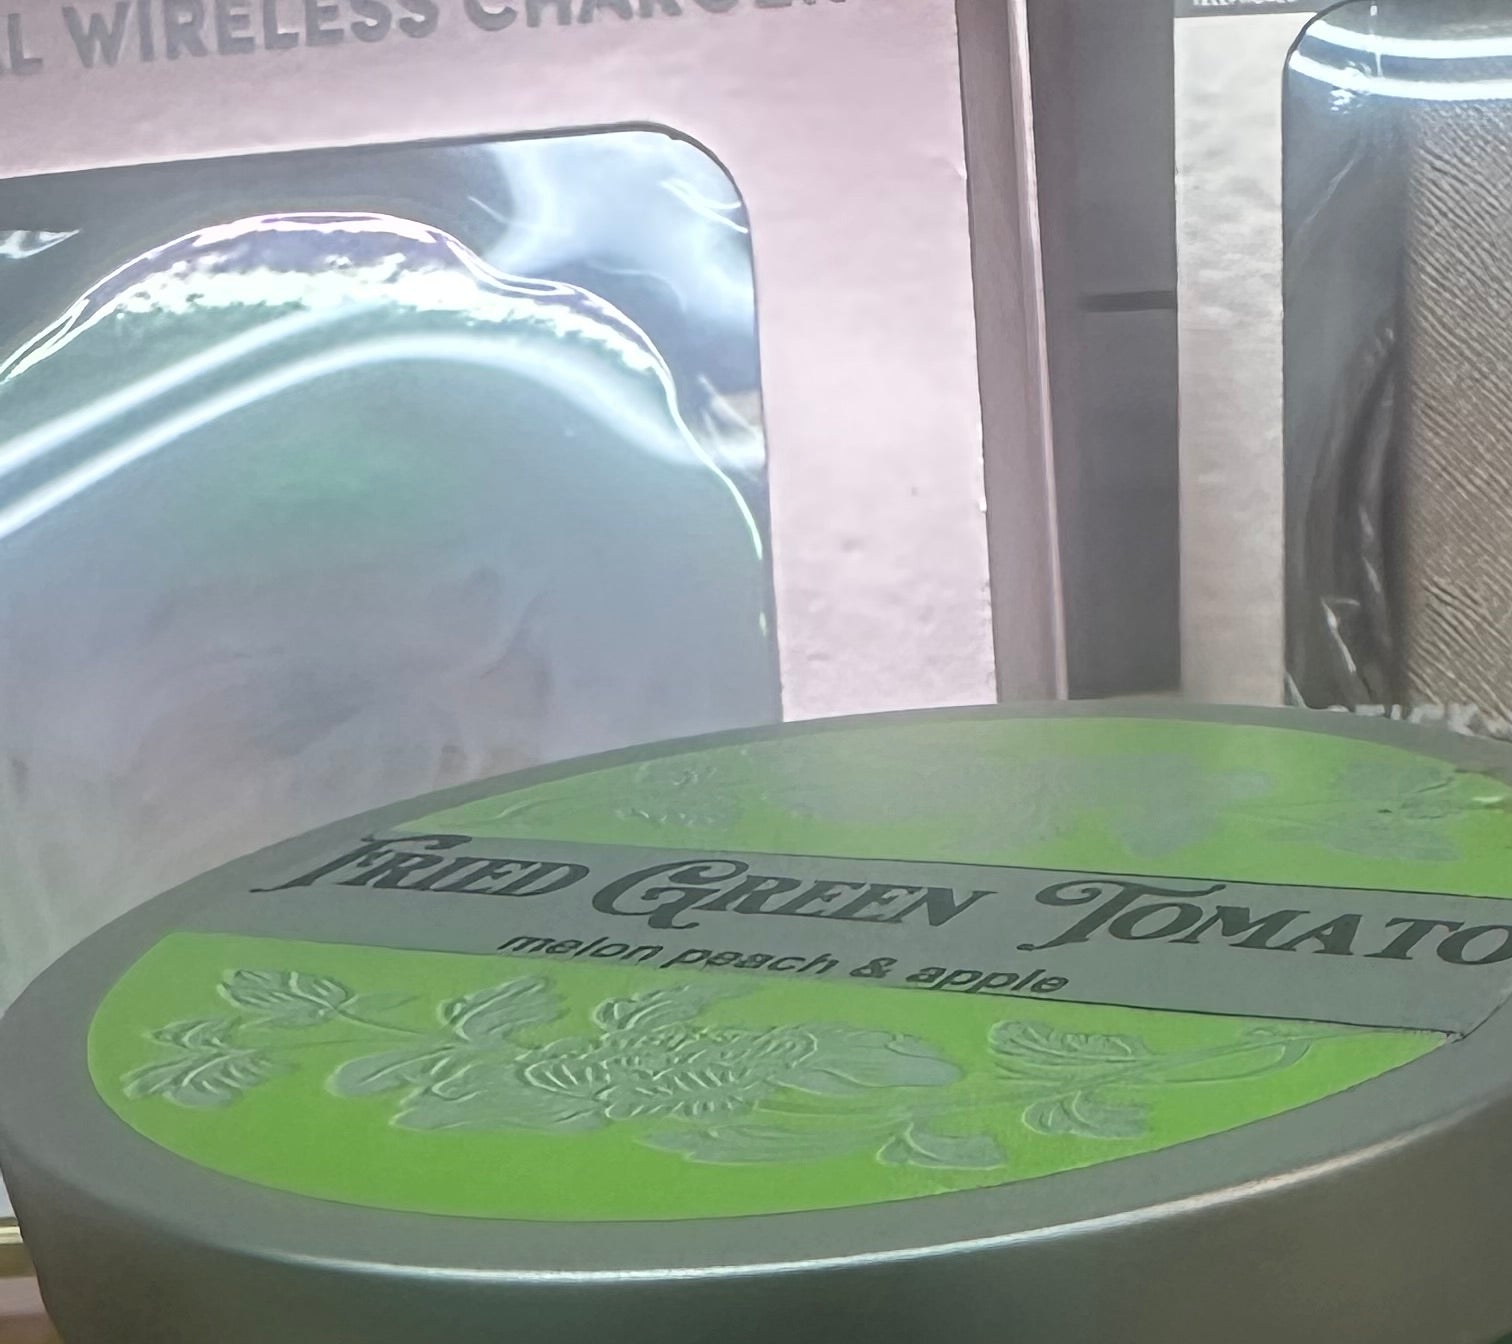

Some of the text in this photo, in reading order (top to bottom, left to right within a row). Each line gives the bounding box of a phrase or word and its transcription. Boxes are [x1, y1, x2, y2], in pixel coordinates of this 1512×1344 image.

[61, 0, 440, 68] WIRELESS
[250, 833, 590, 897] FRIED
[591, 859, 998, 930] GREEN
[497, 935, 1070, 994] melon peach & apple
